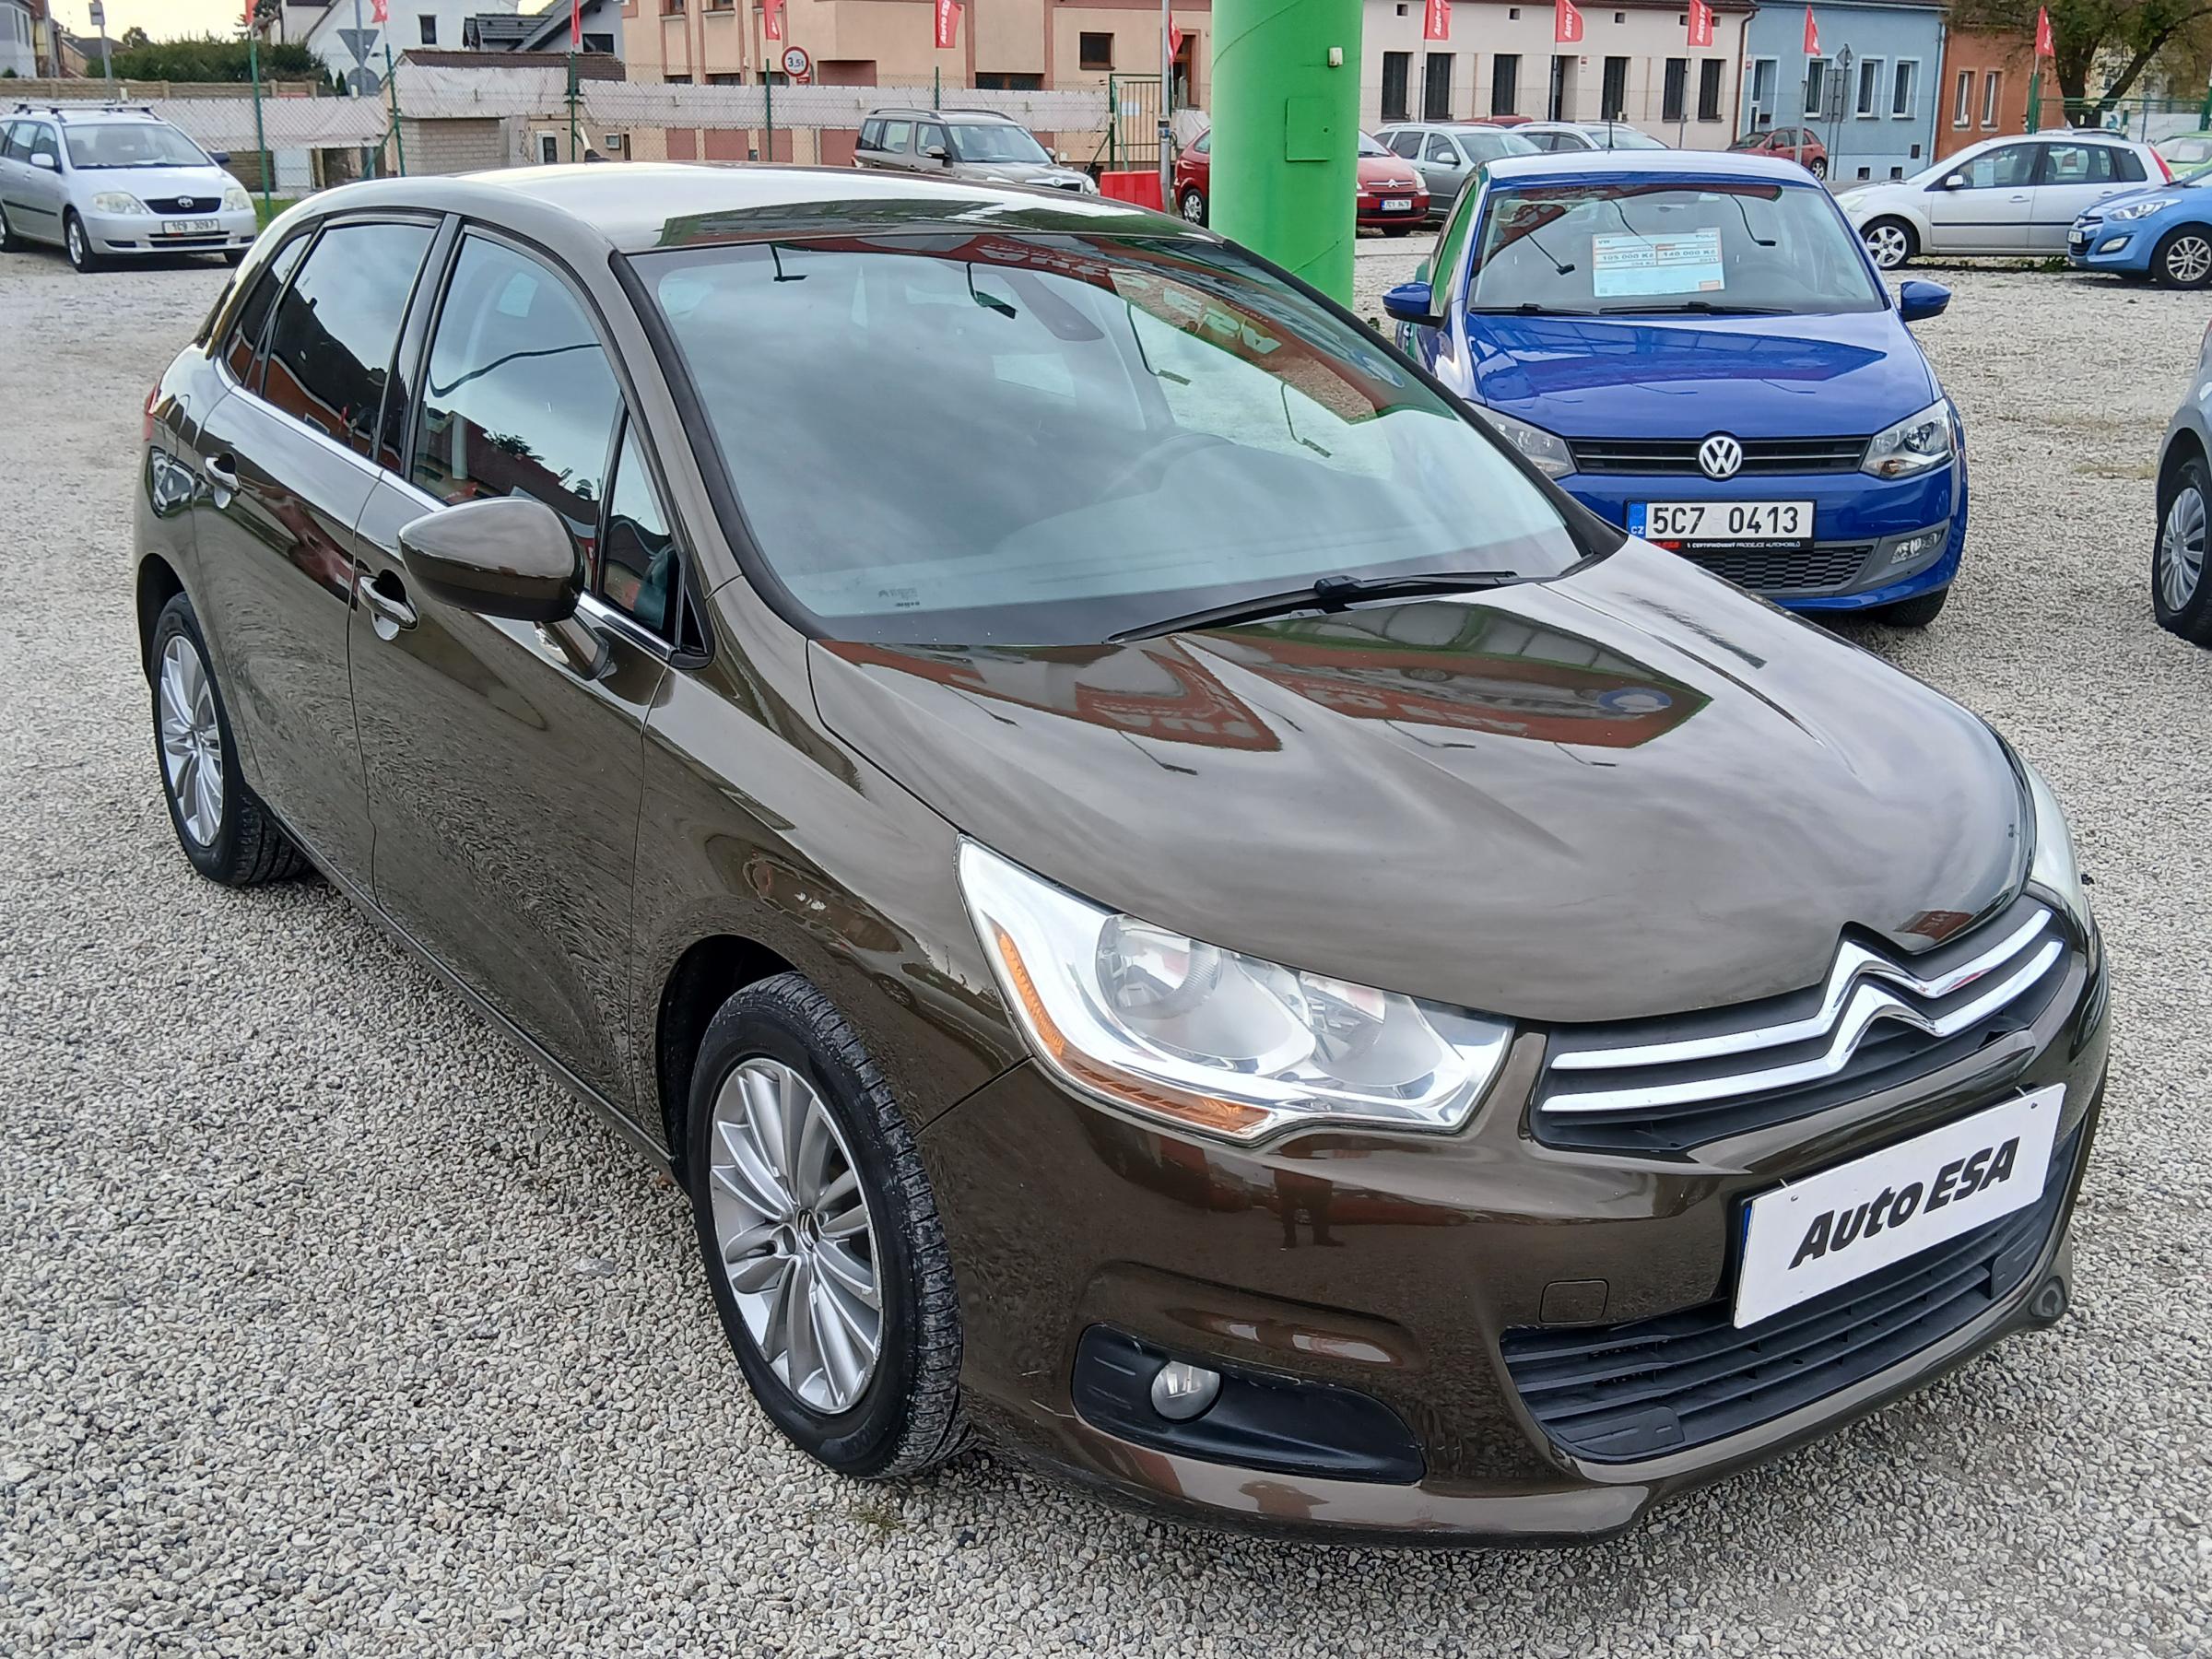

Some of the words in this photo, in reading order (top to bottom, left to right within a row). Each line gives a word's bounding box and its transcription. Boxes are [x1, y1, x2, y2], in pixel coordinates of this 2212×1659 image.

[1564, 14, 1572, 38] Auto
[1630, 525, 1644, 535] CZ
[1653, 507, 1705, 534] 5C7
[1728, 507, 1798, 534] 0413
[1788, 1182, 1924, 1270] Auto
[1924, 1135, 2020, 1215] ESA
